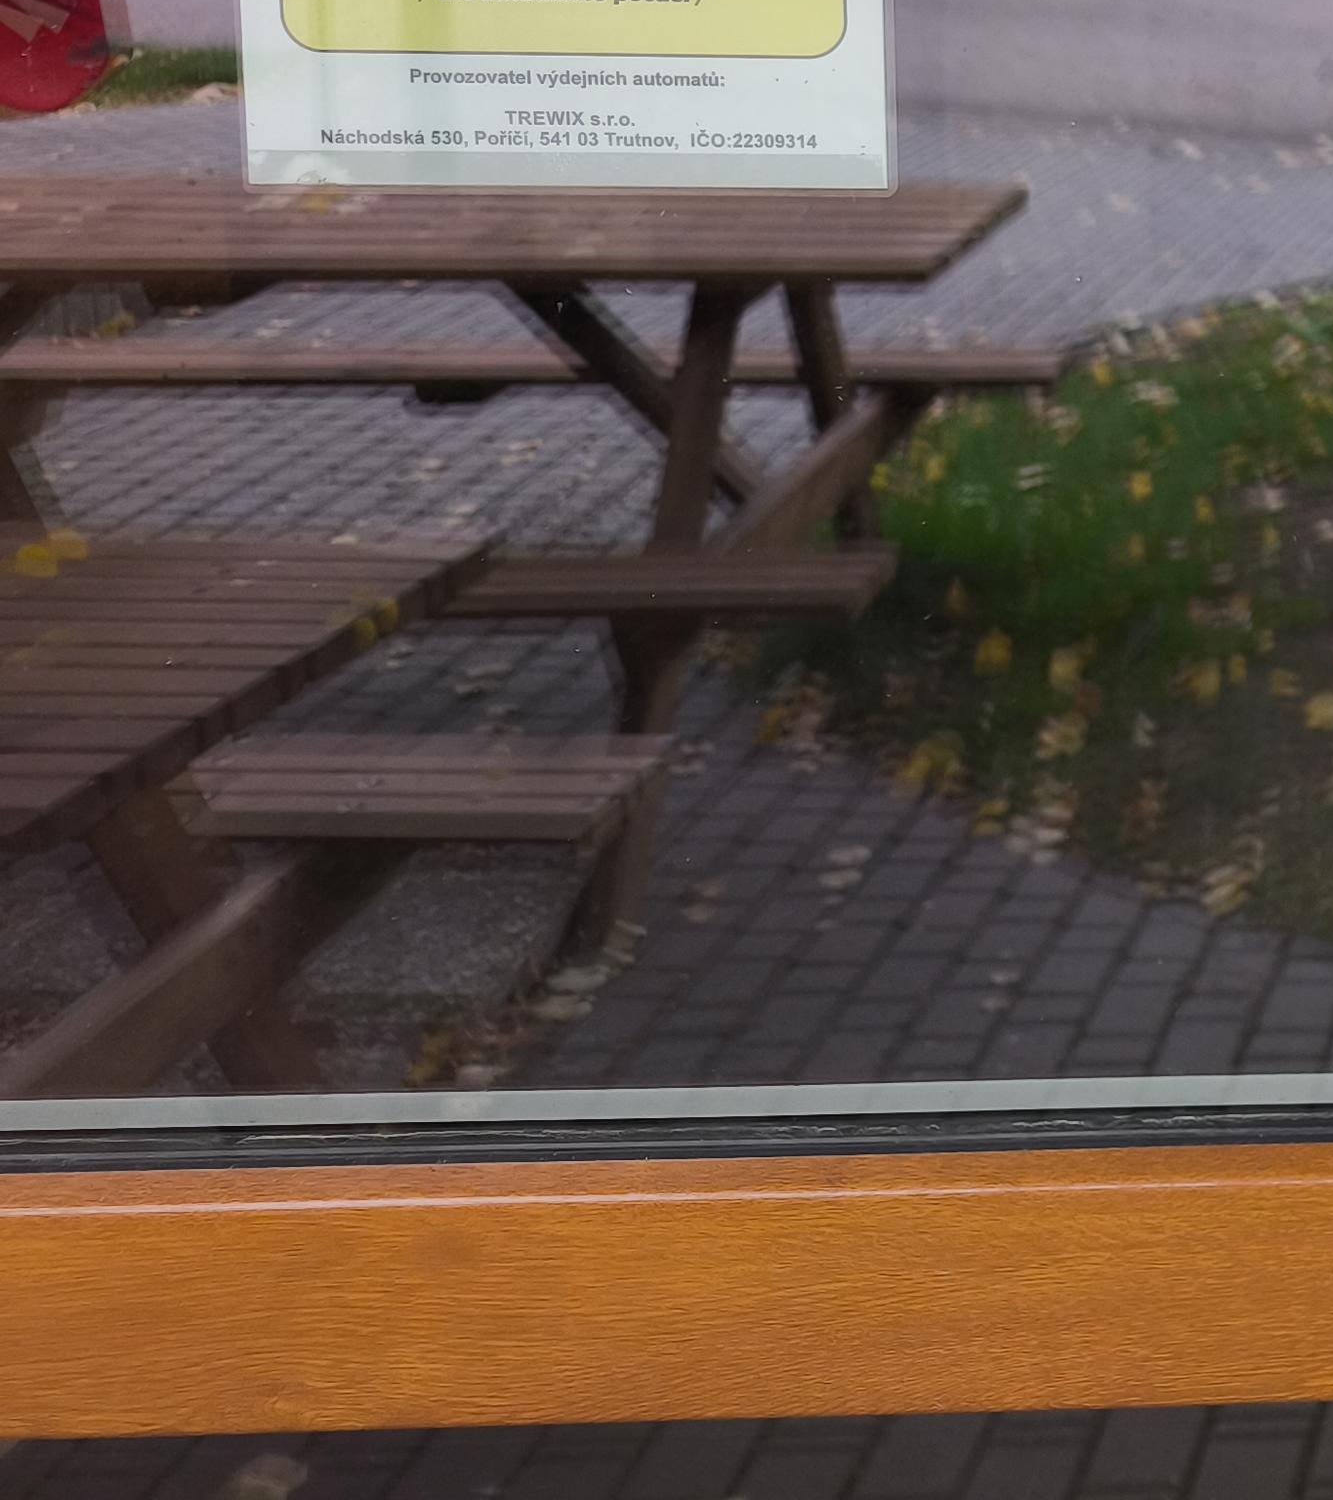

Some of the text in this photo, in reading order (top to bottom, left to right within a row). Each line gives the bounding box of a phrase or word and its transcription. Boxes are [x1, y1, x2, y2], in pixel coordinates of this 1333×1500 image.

[409, 68, 726, 89] Provozovatel výdejních automatů:
[505, 111, 636, 127] TREWIX s.r.o.
[321, 129, 817, 151] Náchodská 530, Poříčí, 541 03 Trutnov, IČO:22309314
